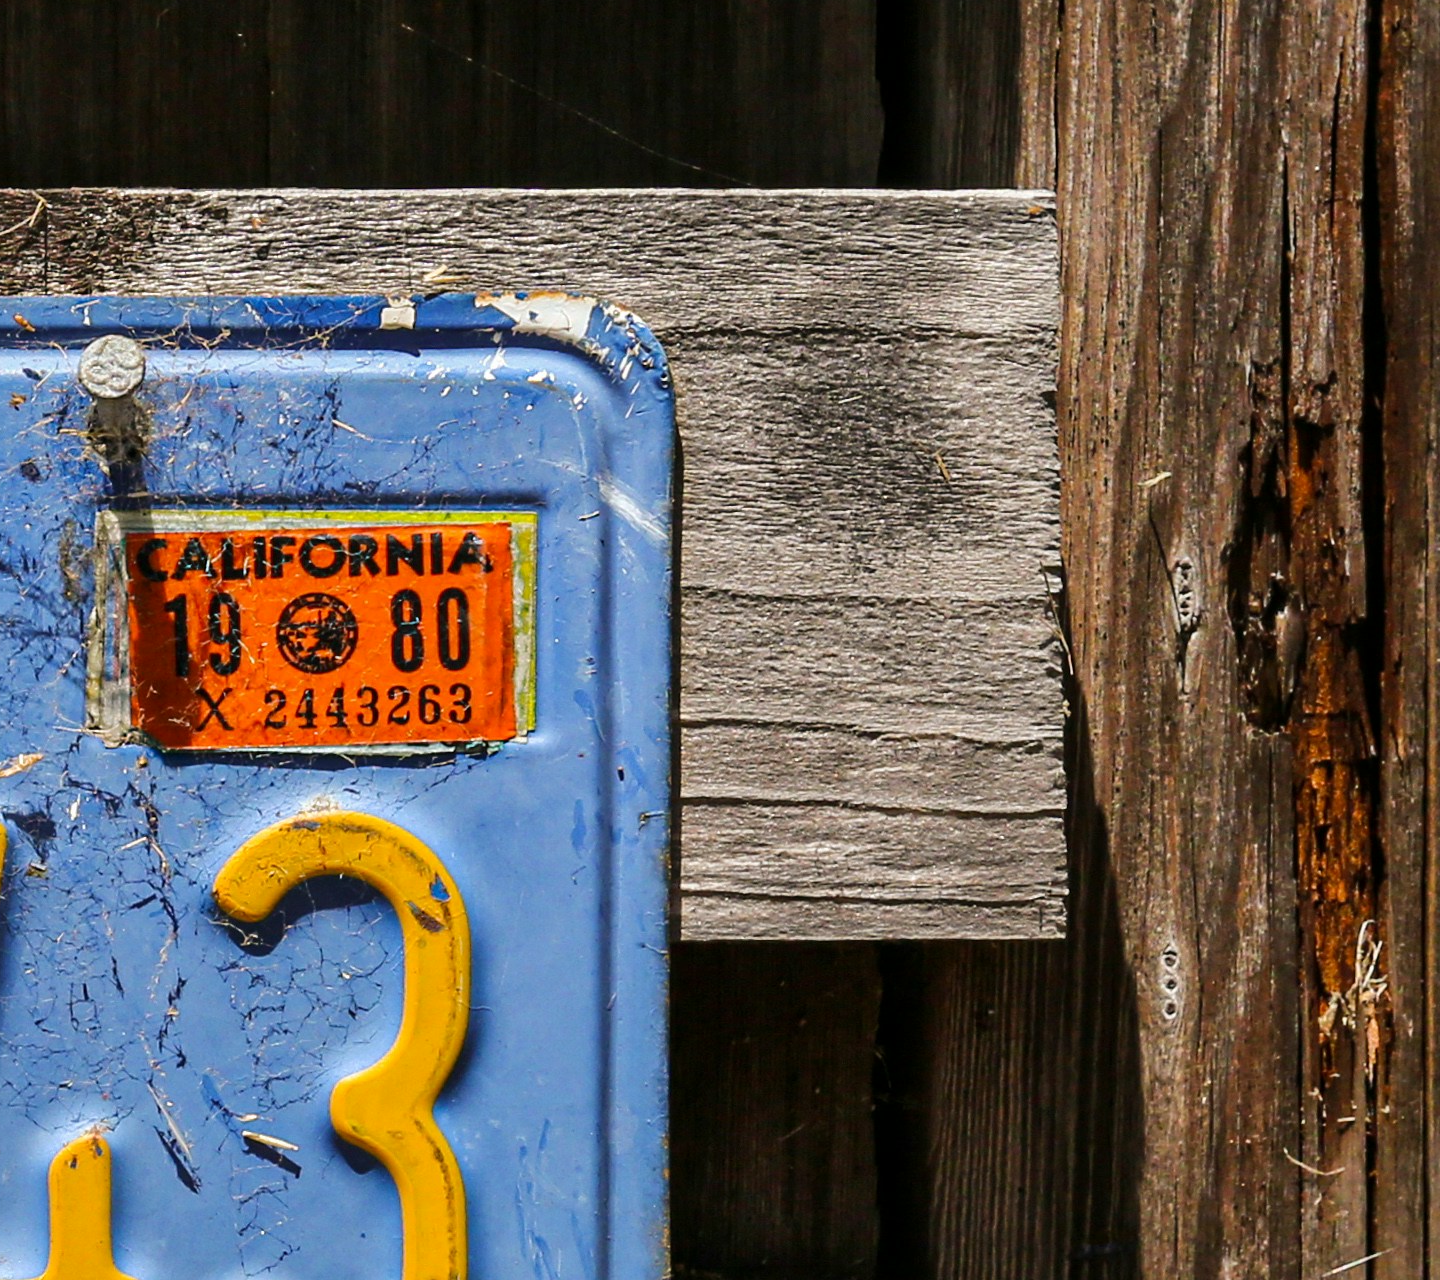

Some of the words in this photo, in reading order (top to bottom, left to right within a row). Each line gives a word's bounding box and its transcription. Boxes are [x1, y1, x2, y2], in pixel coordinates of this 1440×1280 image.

[135, 532, 493, 582] CALIFORNIA
[164, 589, 243, 677] 19
[390, 587, 472, 673] 80
[194, 688, 235, 732] X
[263, 683, 473, 729] 2443263
